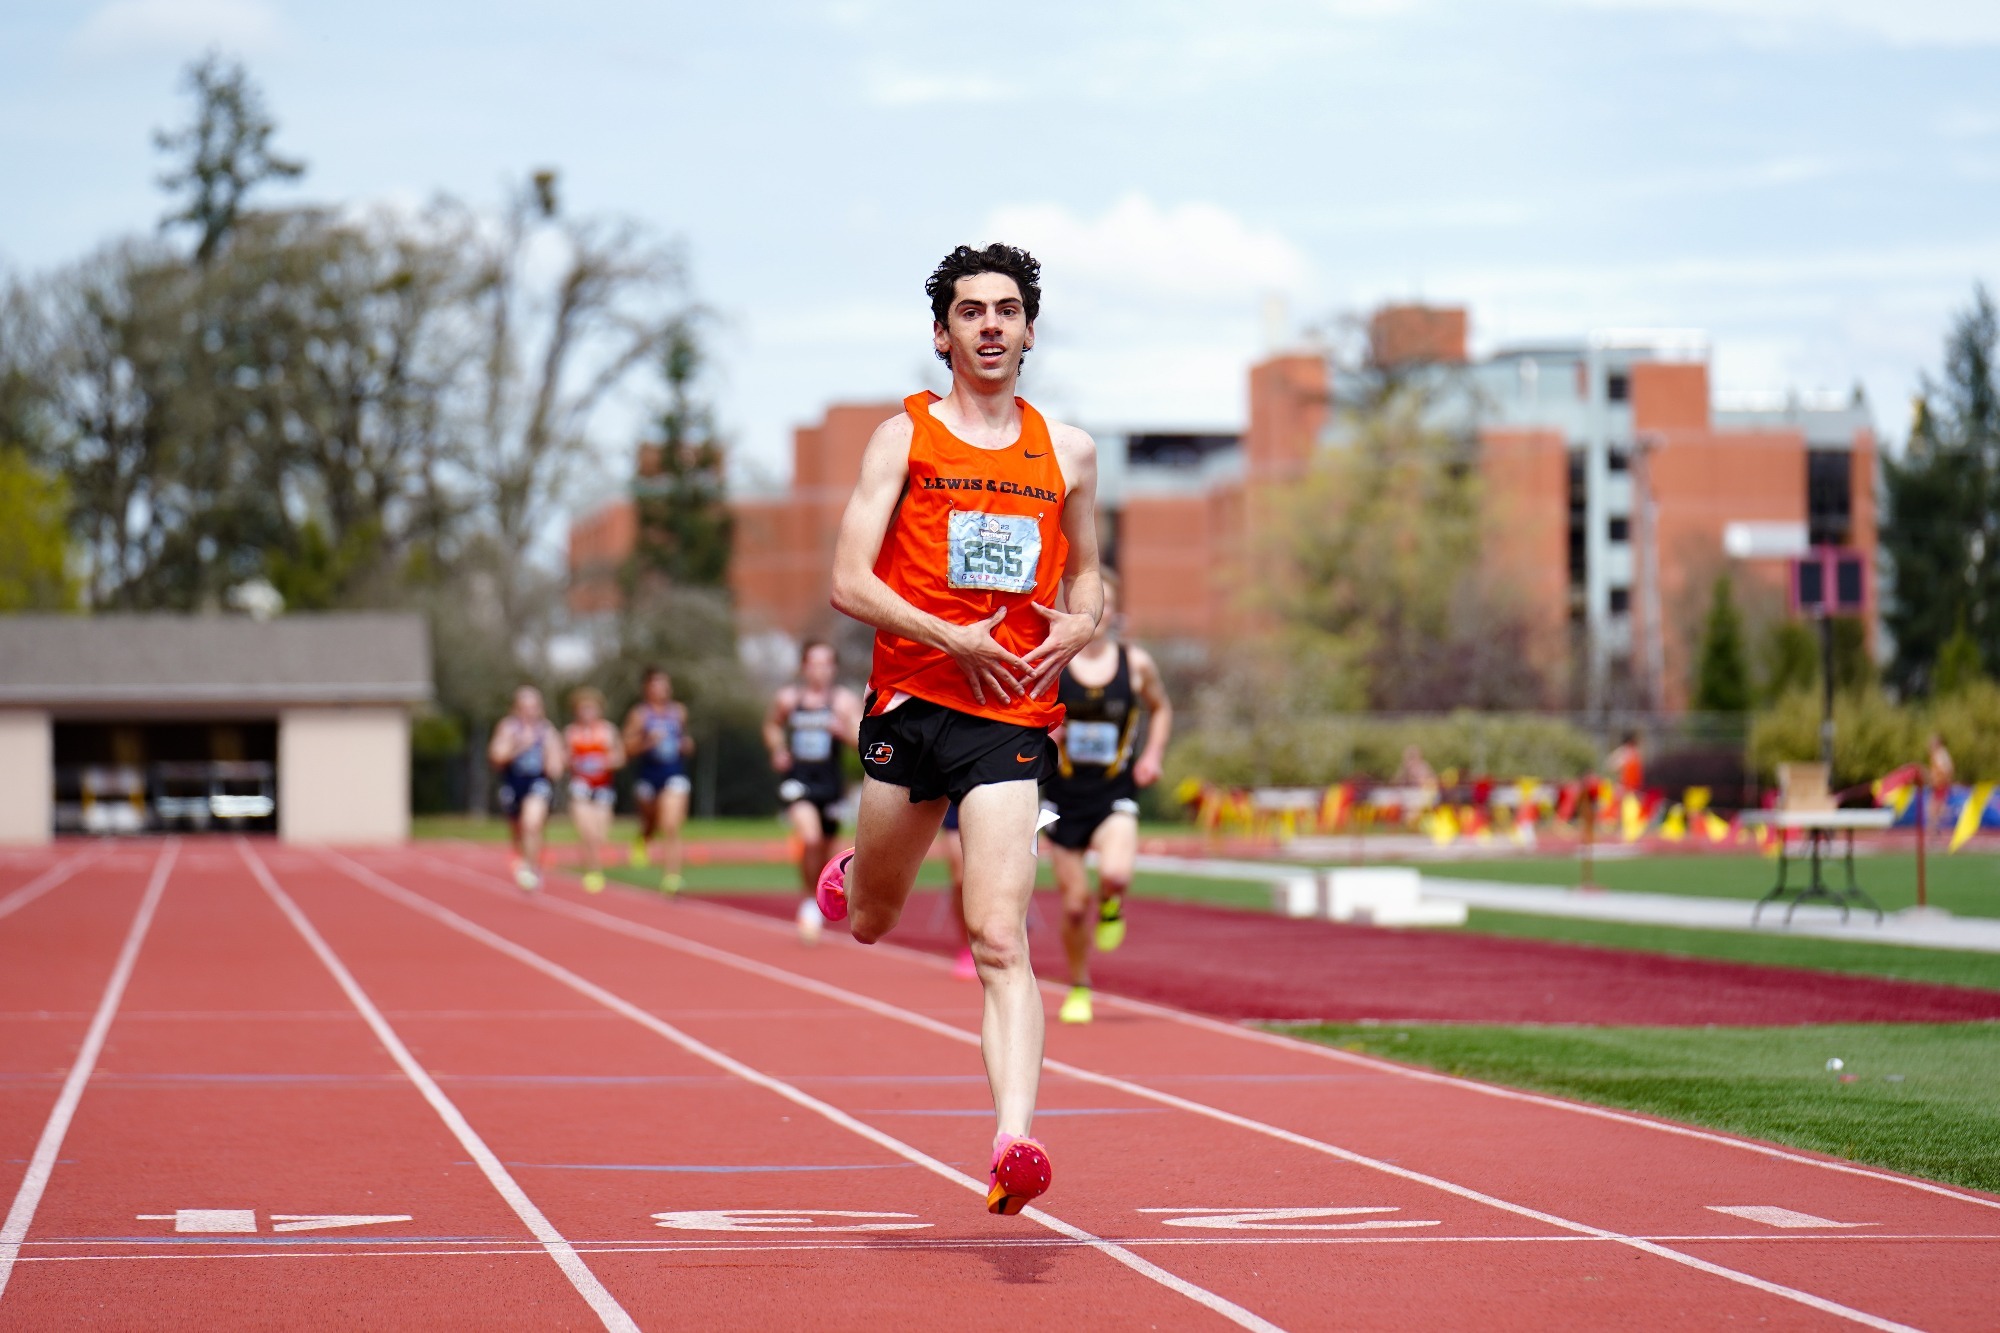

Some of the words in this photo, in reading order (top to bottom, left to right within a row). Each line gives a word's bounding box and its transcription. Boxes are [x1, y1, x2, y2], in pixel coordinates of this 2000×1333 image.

[924, 478, 982, 490] LEWIS
[986, 480, 997, 492] &
[1000, 481, 1057, 503] CLARK
[964, 540, 1022, 577] 255
[136, 1209, 413, 1233] 4
[650, 1209, 935, 1232] 3
[1136, 1207, 1442, 1231] 2
